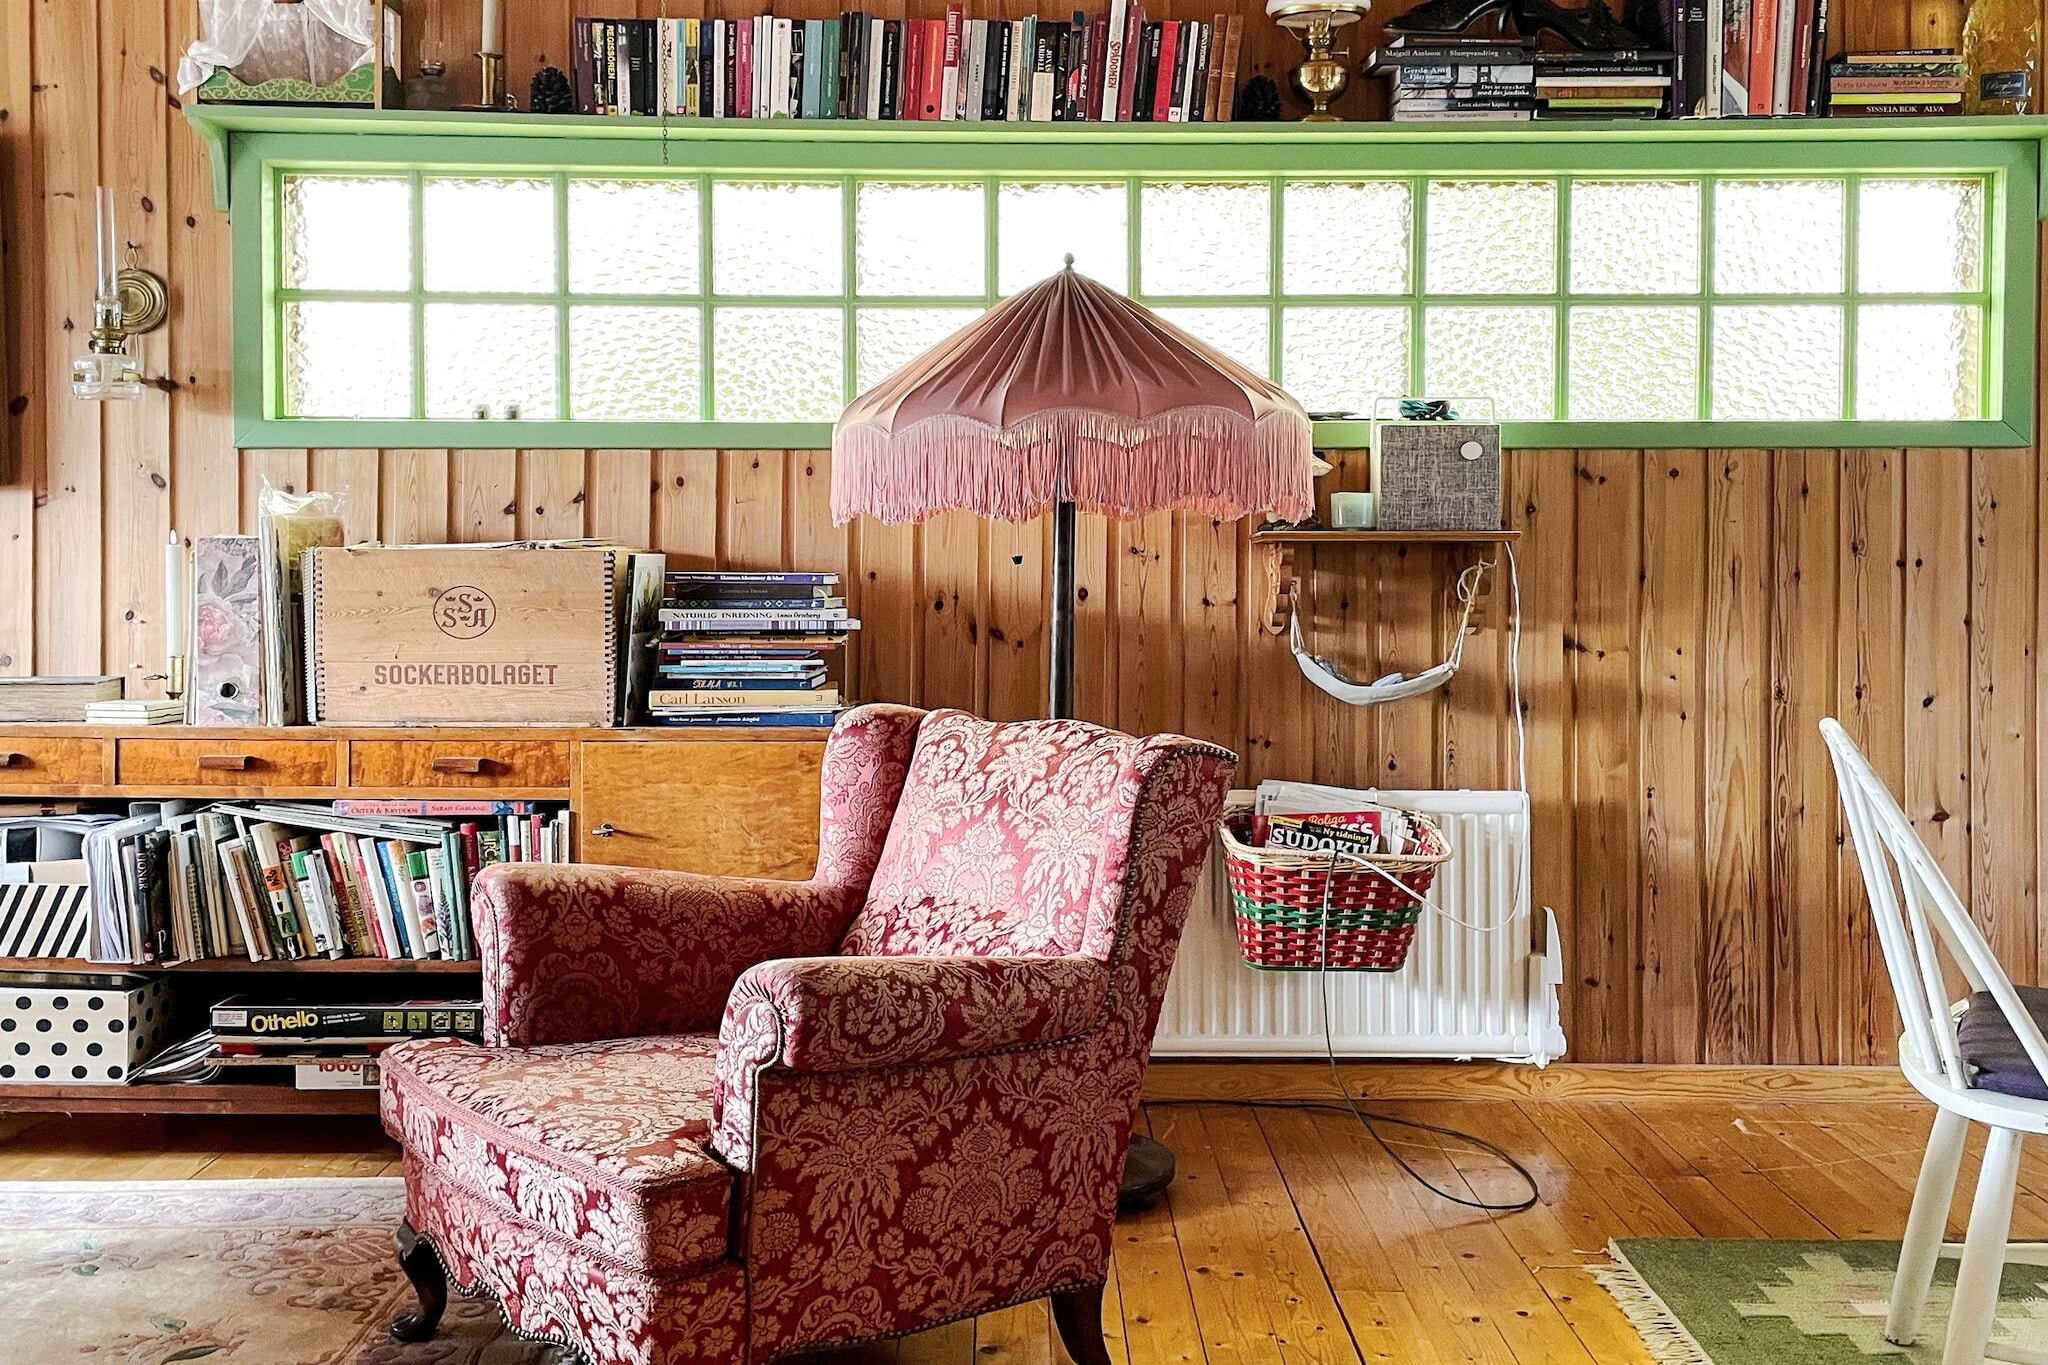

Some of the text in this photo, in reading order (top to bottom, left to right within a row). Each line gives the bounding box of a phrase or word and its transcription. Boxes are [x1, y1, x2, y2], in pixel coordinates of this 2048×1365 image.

[606, 24, 615, 79] REGISSÖREN
[1037, 38, 1046, 72] GARDELL
[1045, 48, 1053, 72] JONAS
[1107, 40, 1121, 89] SPÅDOMEN
[1899, 105, 1917, 113] BOK
[1923, 105, 1944, 113] ALVA
[374, 664, 558, 686] SOCKERBOLAGET
[659, 692, 746, 705] Carl Larsson
[1308, 814, 1347, 827] Roliga
[1272, 828, 1370, 854] SUDOKU
[1322, 827, 1334, 838] Ny
[1336, 829, 1369, 844] tidning!
[250, 1010, 319, 1033] Othello
